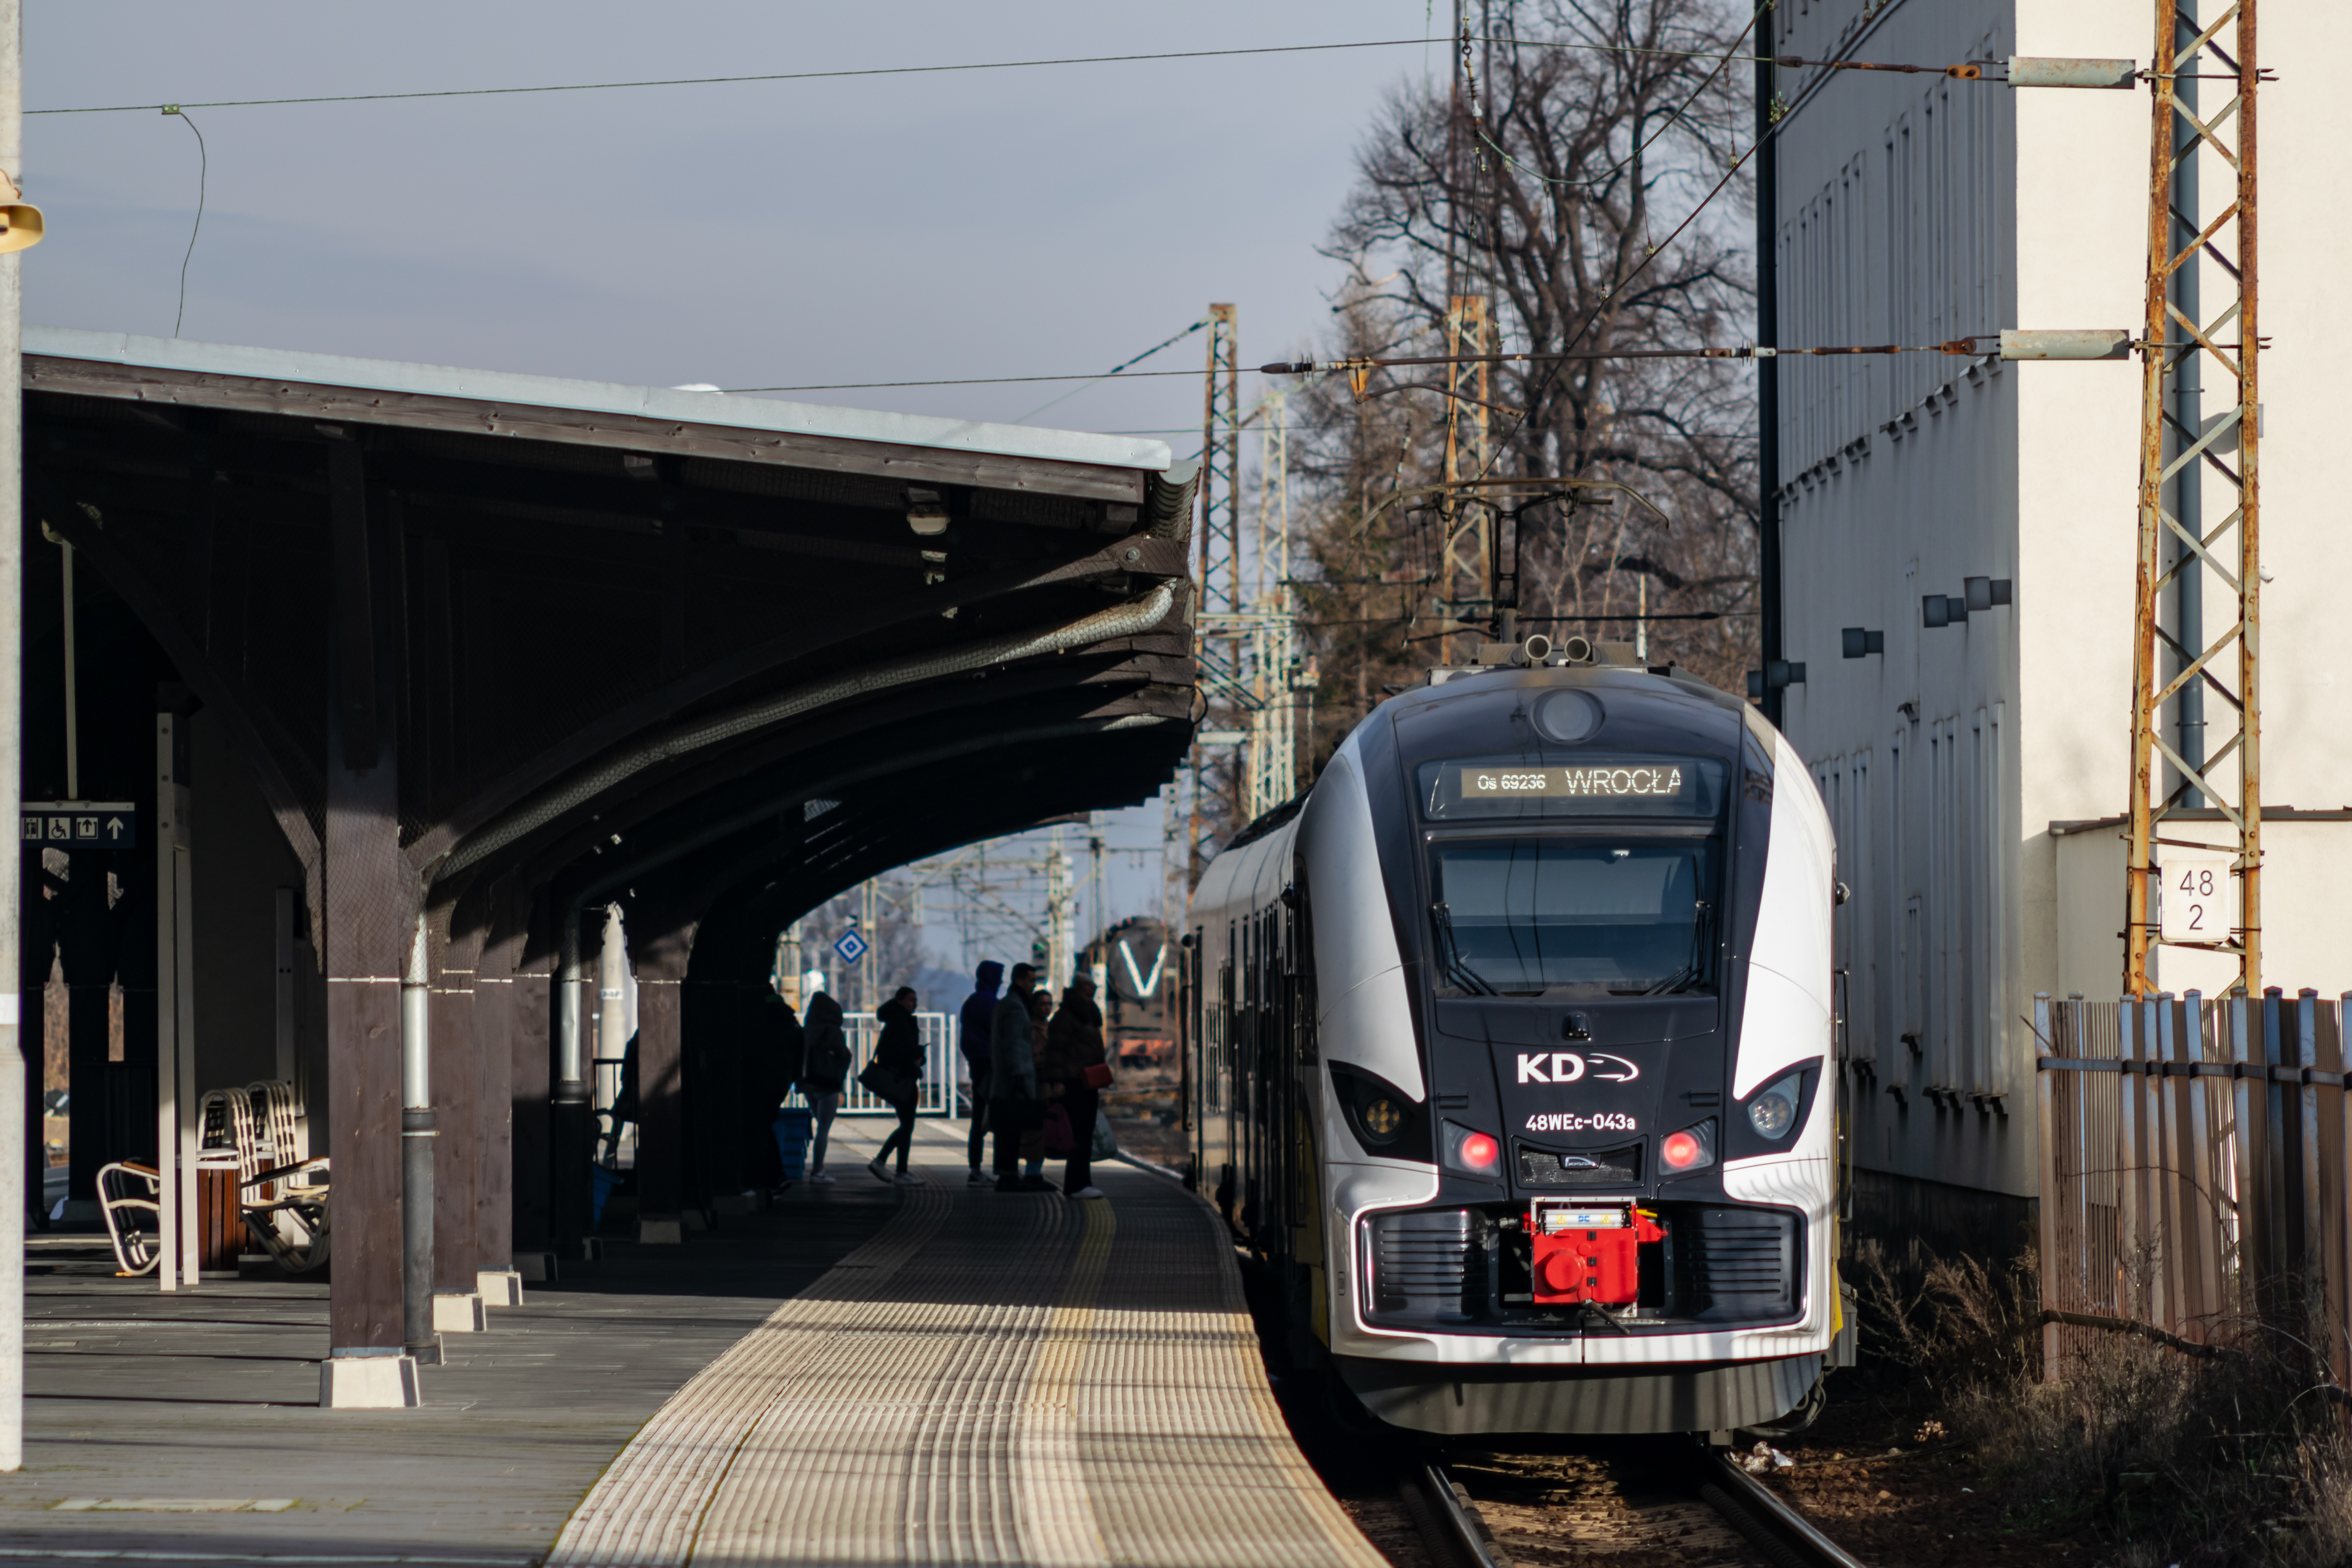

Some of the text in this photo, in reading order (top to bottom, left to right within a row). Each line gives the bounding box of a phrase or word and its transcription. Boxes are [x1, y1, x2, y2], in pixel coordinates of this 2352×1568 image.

[1501, 774, 1546, 789] 69236
[2180, 870, 2213, 896] 48
[2189, 904, 2203, 930] 2
[1518, 1053, 1584, 1083] KD
[1526, 1113, 1636, 1131] 48WEc-043a
